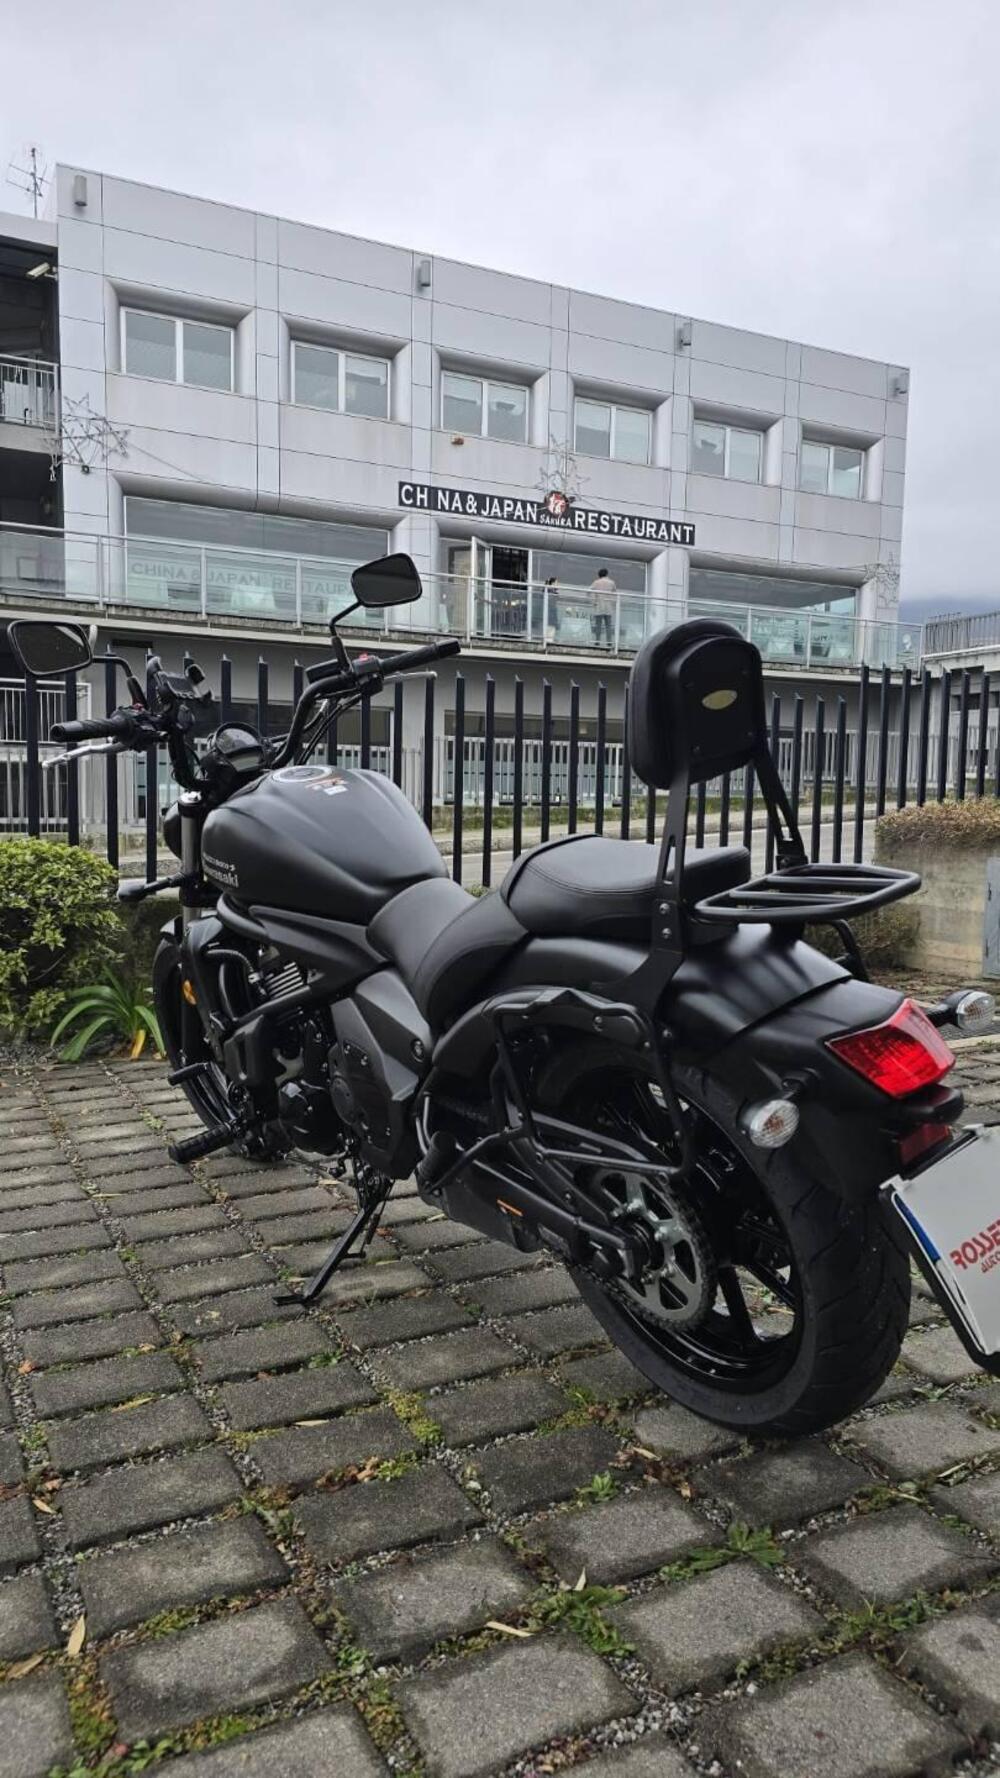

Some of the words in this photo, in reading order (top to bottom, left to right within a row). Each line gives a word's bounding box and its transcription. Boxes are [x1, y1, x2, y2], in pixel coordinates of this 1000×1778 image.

[574, 510, 694, 543] RESTAURANT
[131, 562, 187, 581] CHINA
[207, 570, 261, 586] JAPAN
[272, 576, 352, 595] RETAUR
